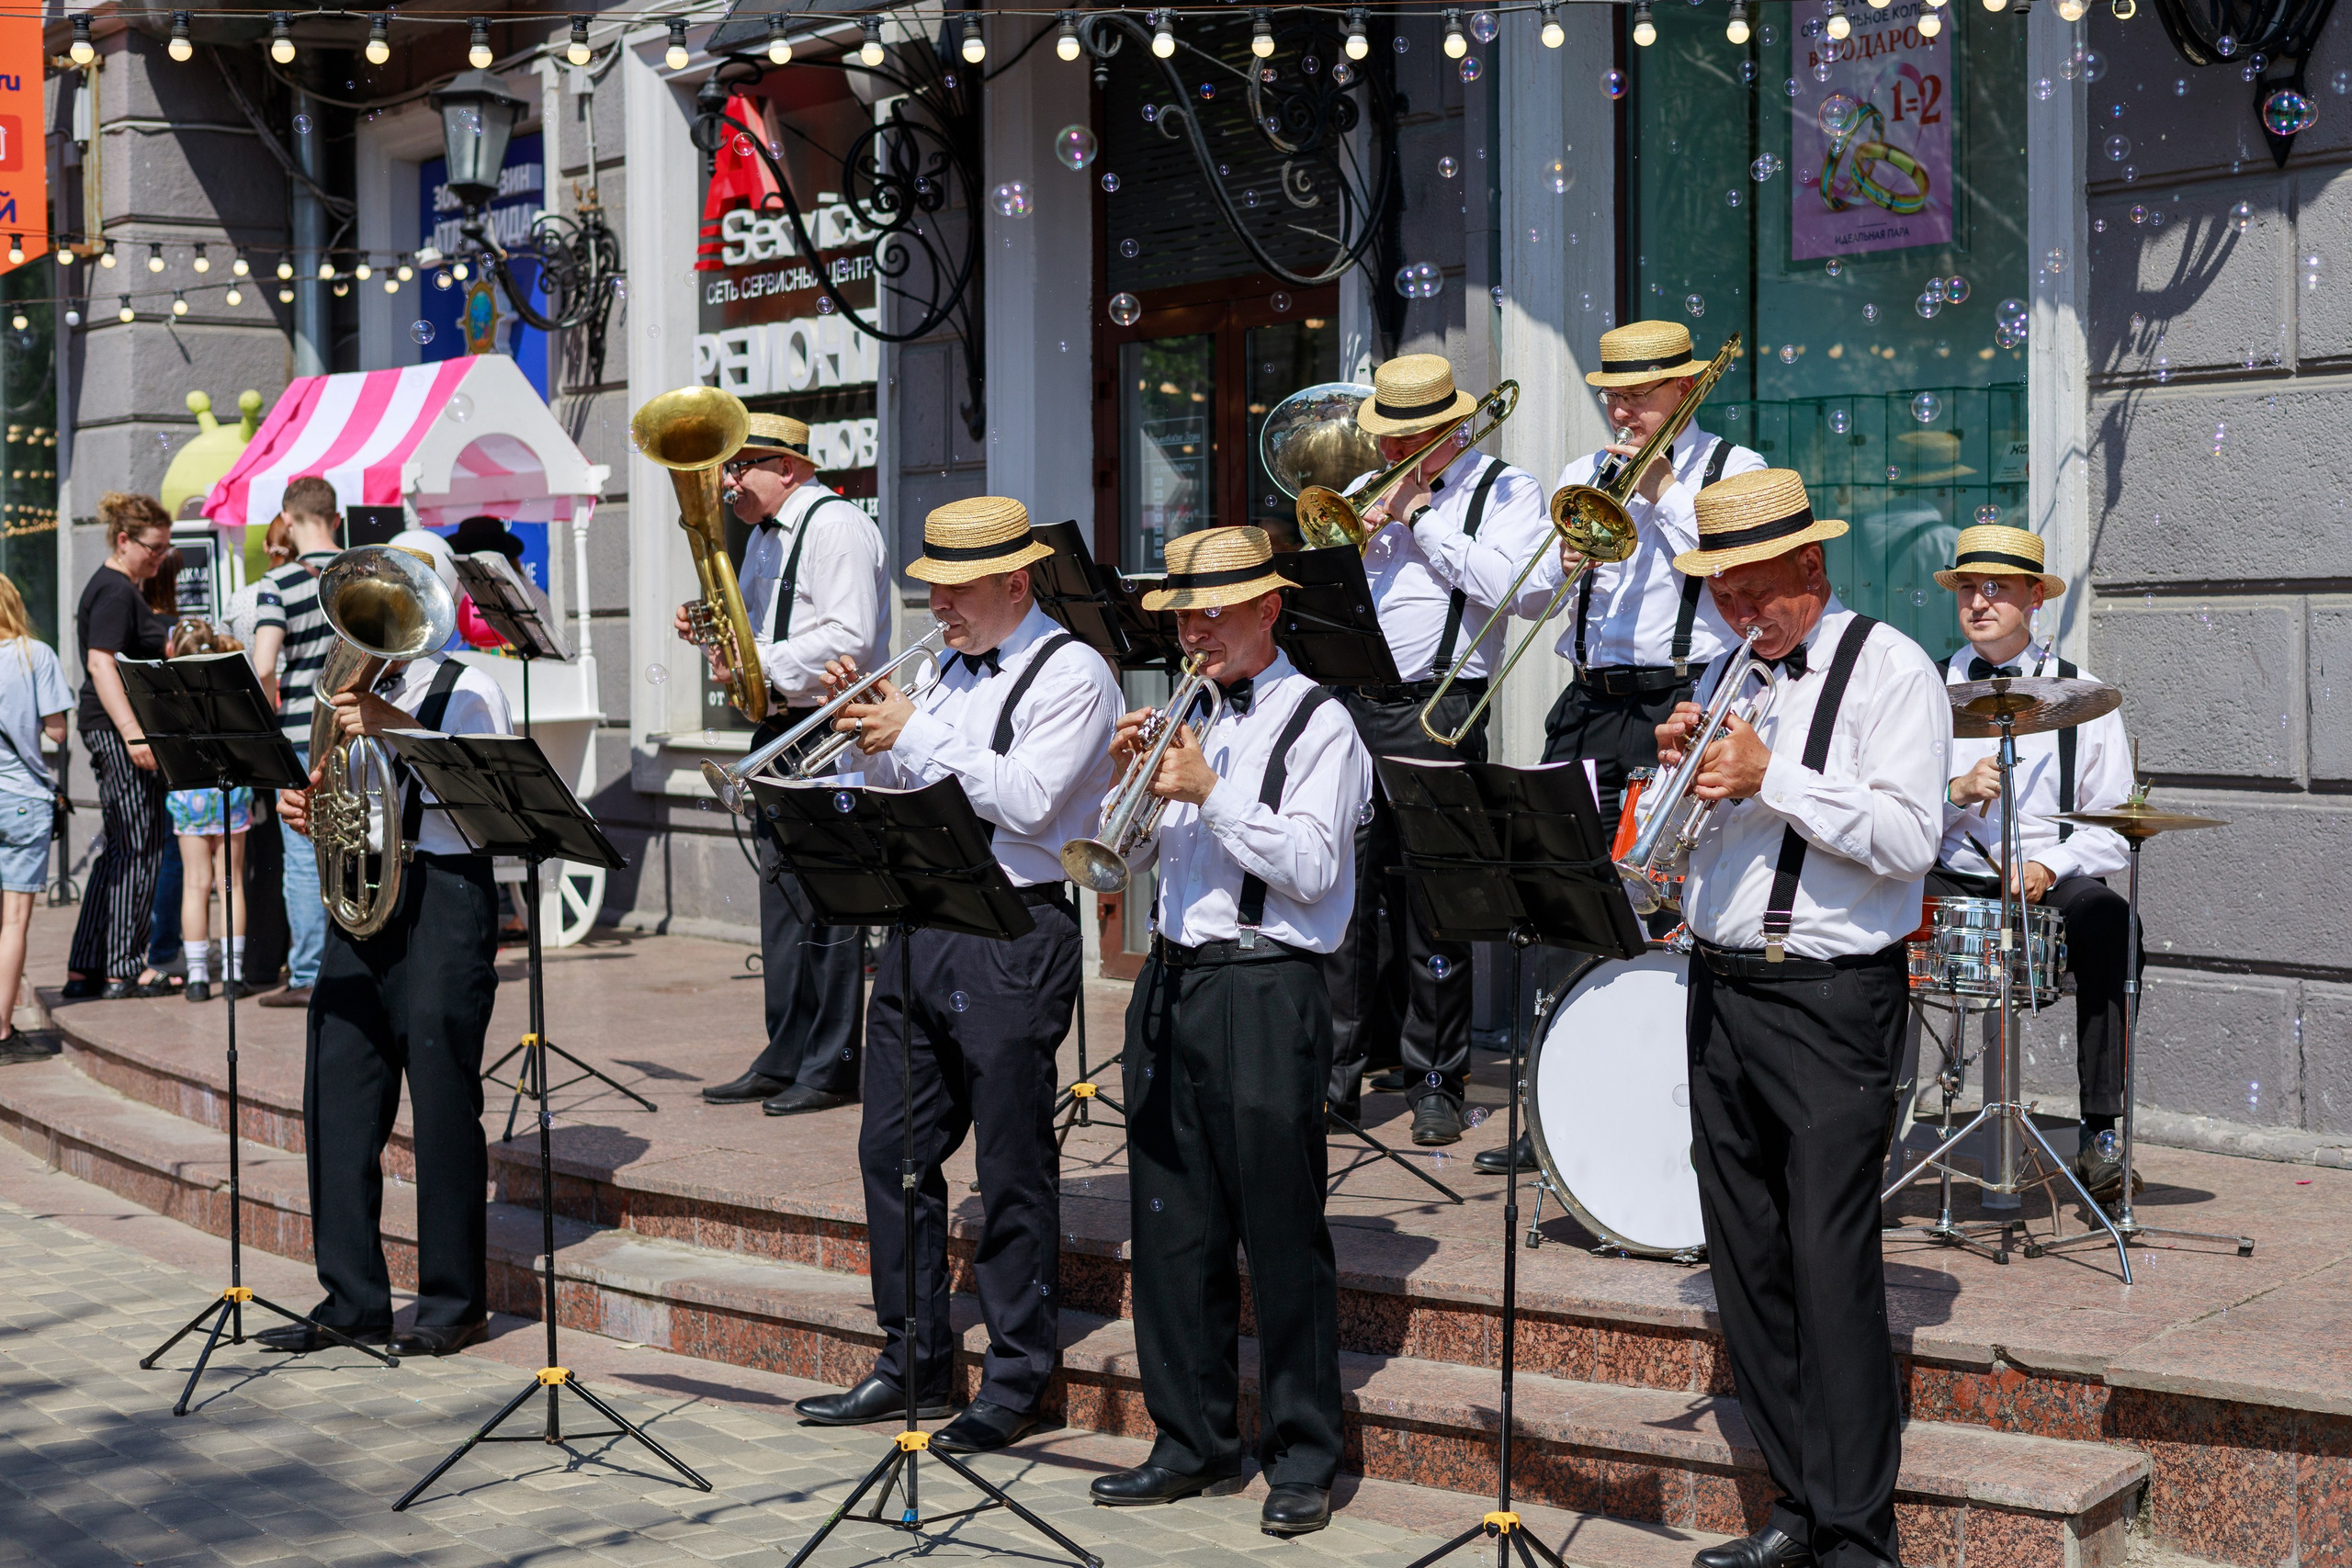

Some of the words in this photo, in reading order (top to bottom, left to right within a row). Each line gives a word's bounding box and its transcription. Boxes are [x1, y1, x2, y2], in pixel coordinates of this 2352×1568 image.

[1801, 10, 1889, 38] ОБРЛЬНОЕ
[1890, 74, 1942, 126] 1=2
[1835, 229, 1885, 245] ИДЕАЛЬНАЯ
[1887, 227, 1910, 239] ПАРА
[706, 279, 739, 305] СЕТЬ
[741, 266, 819, 299] СЕРВИСНЫ
[826, 255, 875, 288] ЦЕНТР
[693, 309, 878, 398] РЕМОНТ
[707, 691, 725, 706] ОТ
